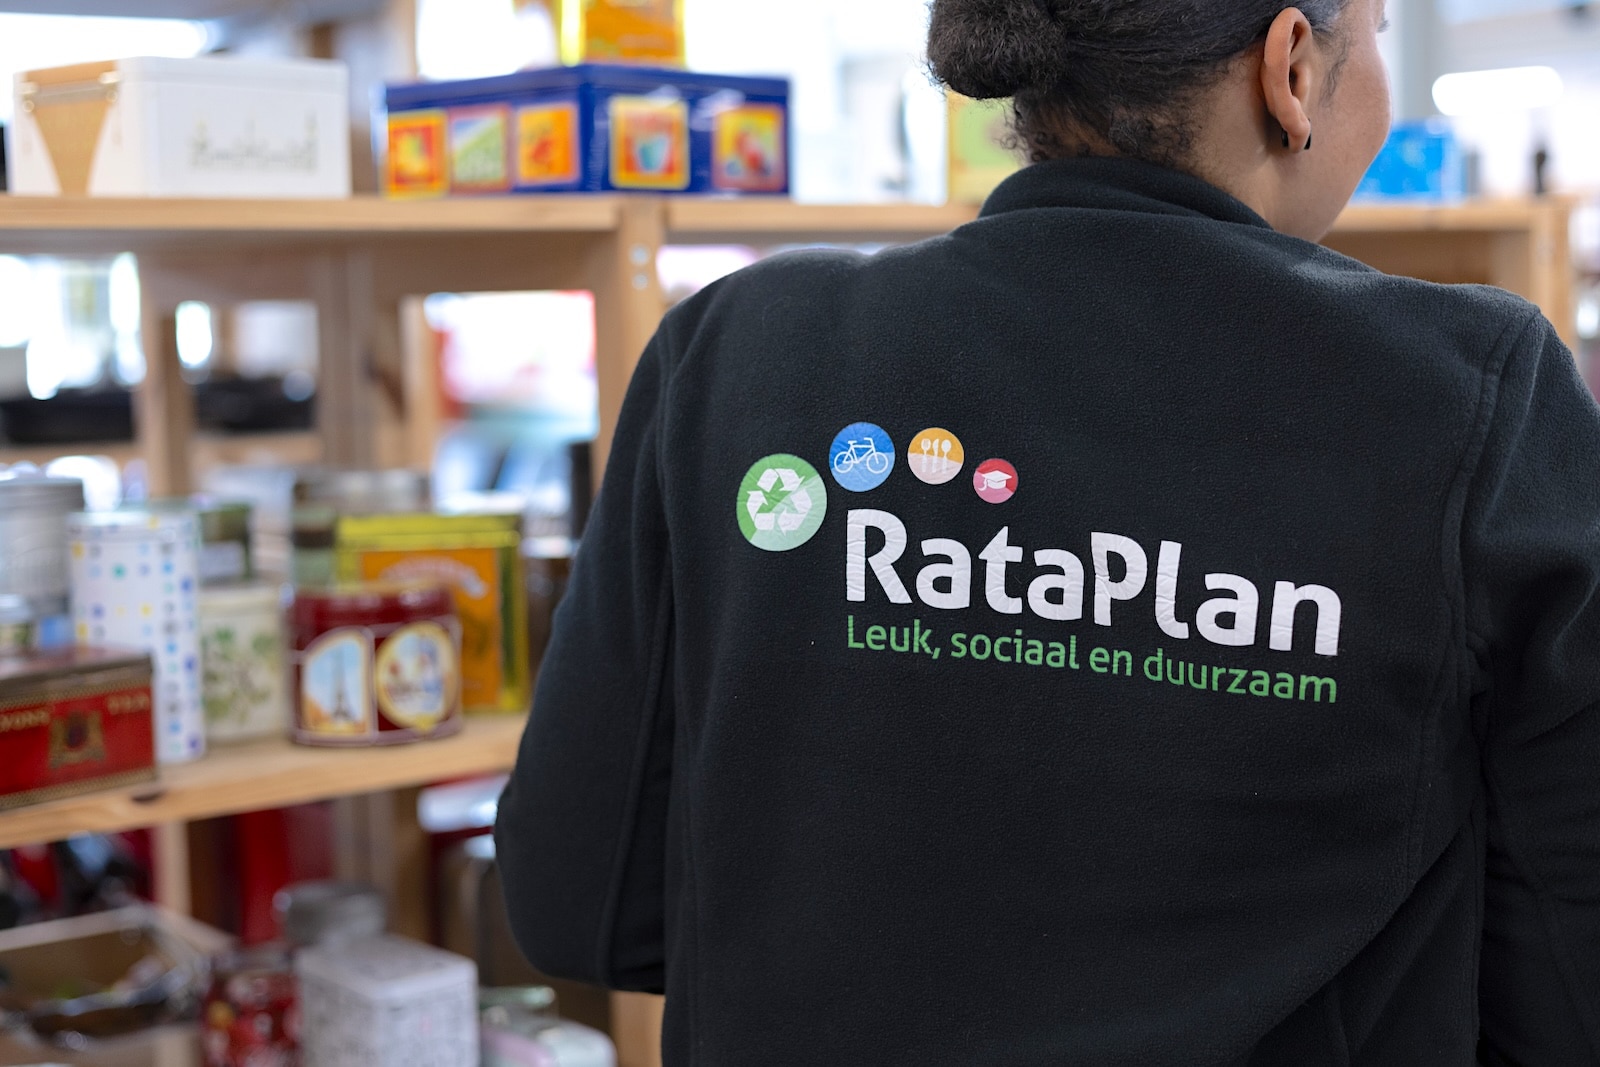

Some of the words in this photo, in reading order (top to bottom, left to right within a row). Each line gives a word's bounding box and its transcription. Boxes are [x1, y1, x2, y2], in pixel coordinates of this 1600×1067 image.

[846, 508, 1342, 656] RataPlan
[847, 615, 940, 660] Leuk,
[950, 628, 1080, 669] sociaal
[1089, 647, 1133, 676] en
[1143, 647, 1337, 703] duurzaam
